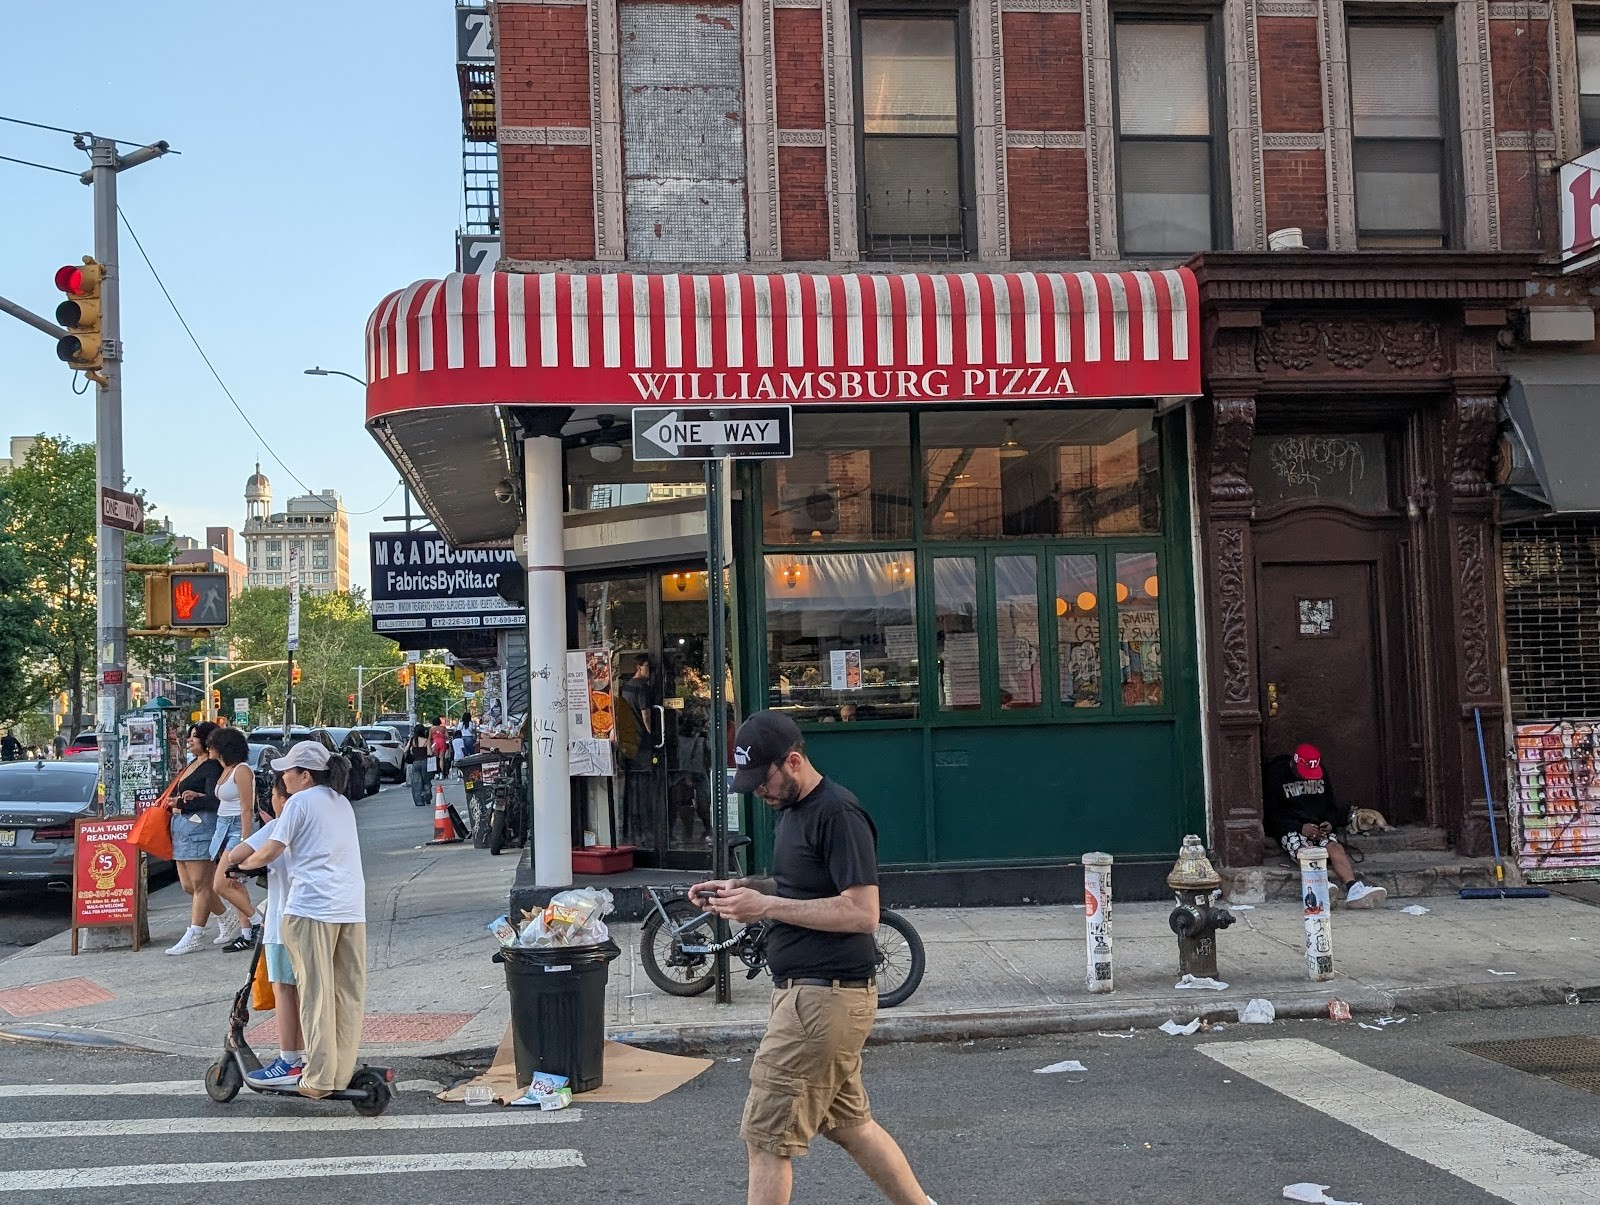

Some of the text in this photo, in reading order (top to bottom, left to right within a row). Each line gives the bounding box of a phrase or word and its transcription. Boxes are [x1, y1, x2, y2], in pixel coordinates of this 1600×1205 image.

[628, 367, 1076, 400] WILLIAMSBURG PIZZA
[659, 422, 770, 443] ONE WAY
[105, 499, 139, 521] ONE WAY
[375, 541, 389, 565] M
[393, 541, 405, 565] &
[410, 541, 421, 565] A
[433, 618, 479, 626] 212-226-3910
[533, 718, 558, 733] KILL
[121, 772, 148, 780] WORKS
[1282, 779, 1325, 798] FRIENDS
[81, 823, 134, 833] PALM TAROT
[86, 833, 128, 842] READINGS
[99, 854, 113, 870] $5
